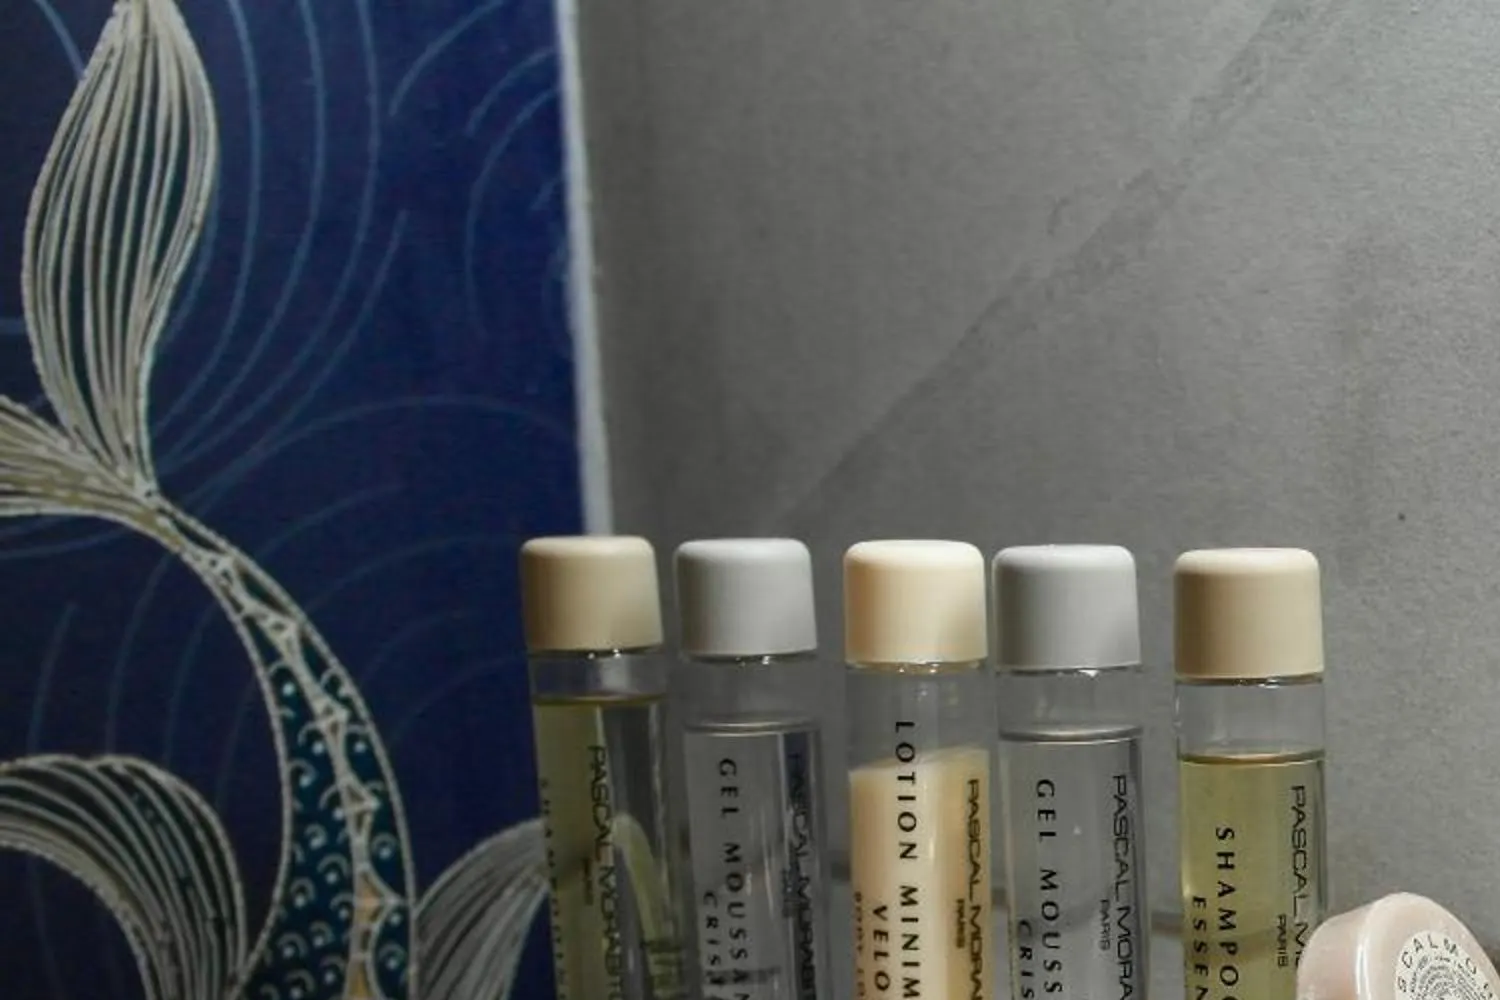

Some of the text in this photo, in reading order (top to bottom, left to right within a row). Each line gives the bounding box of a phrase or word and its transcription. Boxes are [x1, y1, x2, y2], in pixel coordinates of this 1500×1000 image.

[587, 745, 613, 862] PASCAL
[718, 758, 738, 817] GEL
[895, 721, 917, 860] LOTION
[967, 779, 981, 900] PASCAL
[1035, 779, 1057, 841] GEL
[1113, 775, 1130, 900] PASCAL
[1291, 785, 1308, 917] PASCAL
[1100, 899, 1111, 951] PARIS
